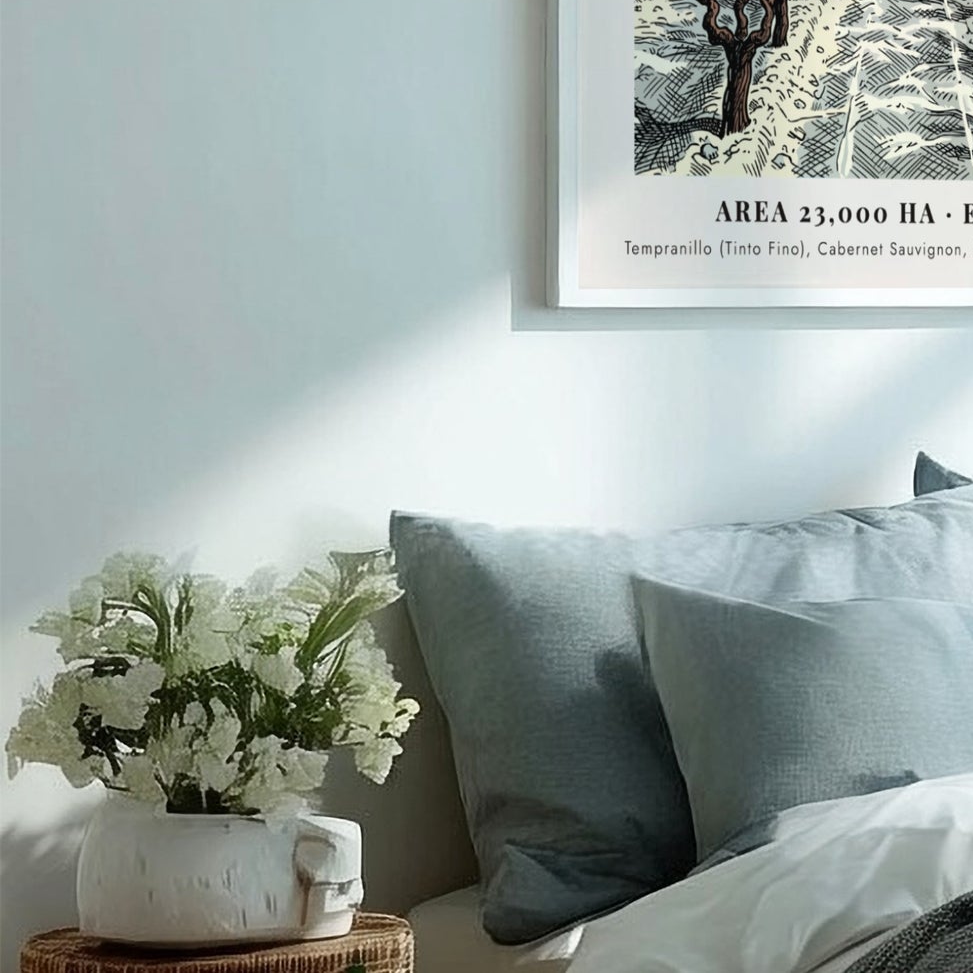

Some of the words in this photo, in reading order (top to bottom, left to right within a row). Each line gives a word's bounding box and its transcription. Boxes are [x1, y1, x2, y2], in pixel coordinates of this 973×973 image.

[715, 200, 788, 223] AREA
[799, 206, 887, 227] 23,000
[899, 202, 935, 224] HA
[624, 239, 712, 259] Tempranillo
[720, 240, 761, 259] (Tinto
[769, 240, 810, 258] Fino),
[818, 240, 883, 256] Cabernet
[890, 242, 966, 259] Sauvignon,
